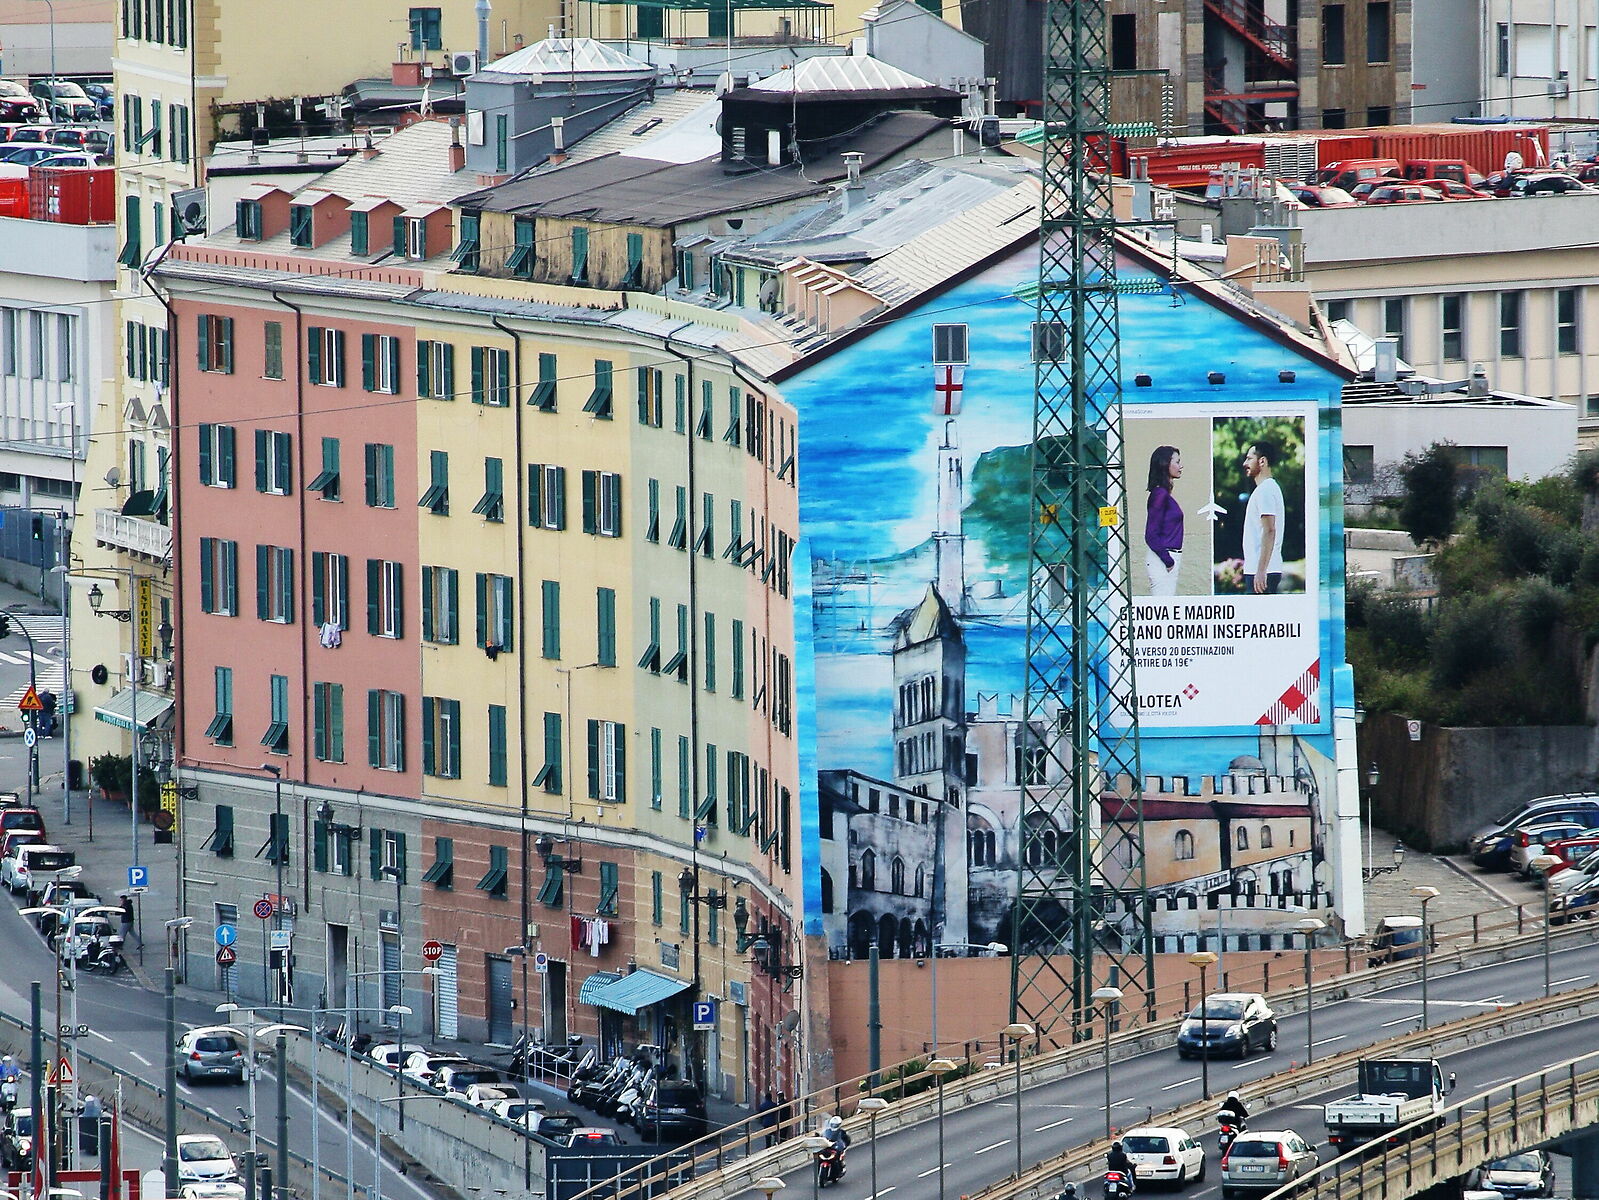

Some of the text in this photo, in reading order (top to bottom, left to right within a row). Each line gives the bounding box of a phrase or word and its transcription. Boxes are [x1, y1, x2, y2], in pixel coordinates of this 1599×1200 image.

[140, 580, 149, 655] RISTORANTE
[1173, 605, 1180, 620] E
[1185, 604, 1235, 620] MADRID
[1167, 624, 1208, 640] ORMAI
[1213, 622, 1301, 639] INSEPARABILI
[1142, 646, 1167, 657] VERSO
[1169, 646, 1179, 657] 20
[1181, 645, 1235, 657] DESTINAZIONI
[1120, 659, 1125, 668] A
[1162, 658, 1173, 668] DA
[131, 869, 144, 885] P
[423, 945, 442, 956] STOP
[698, 1005, 710, 1021] P
